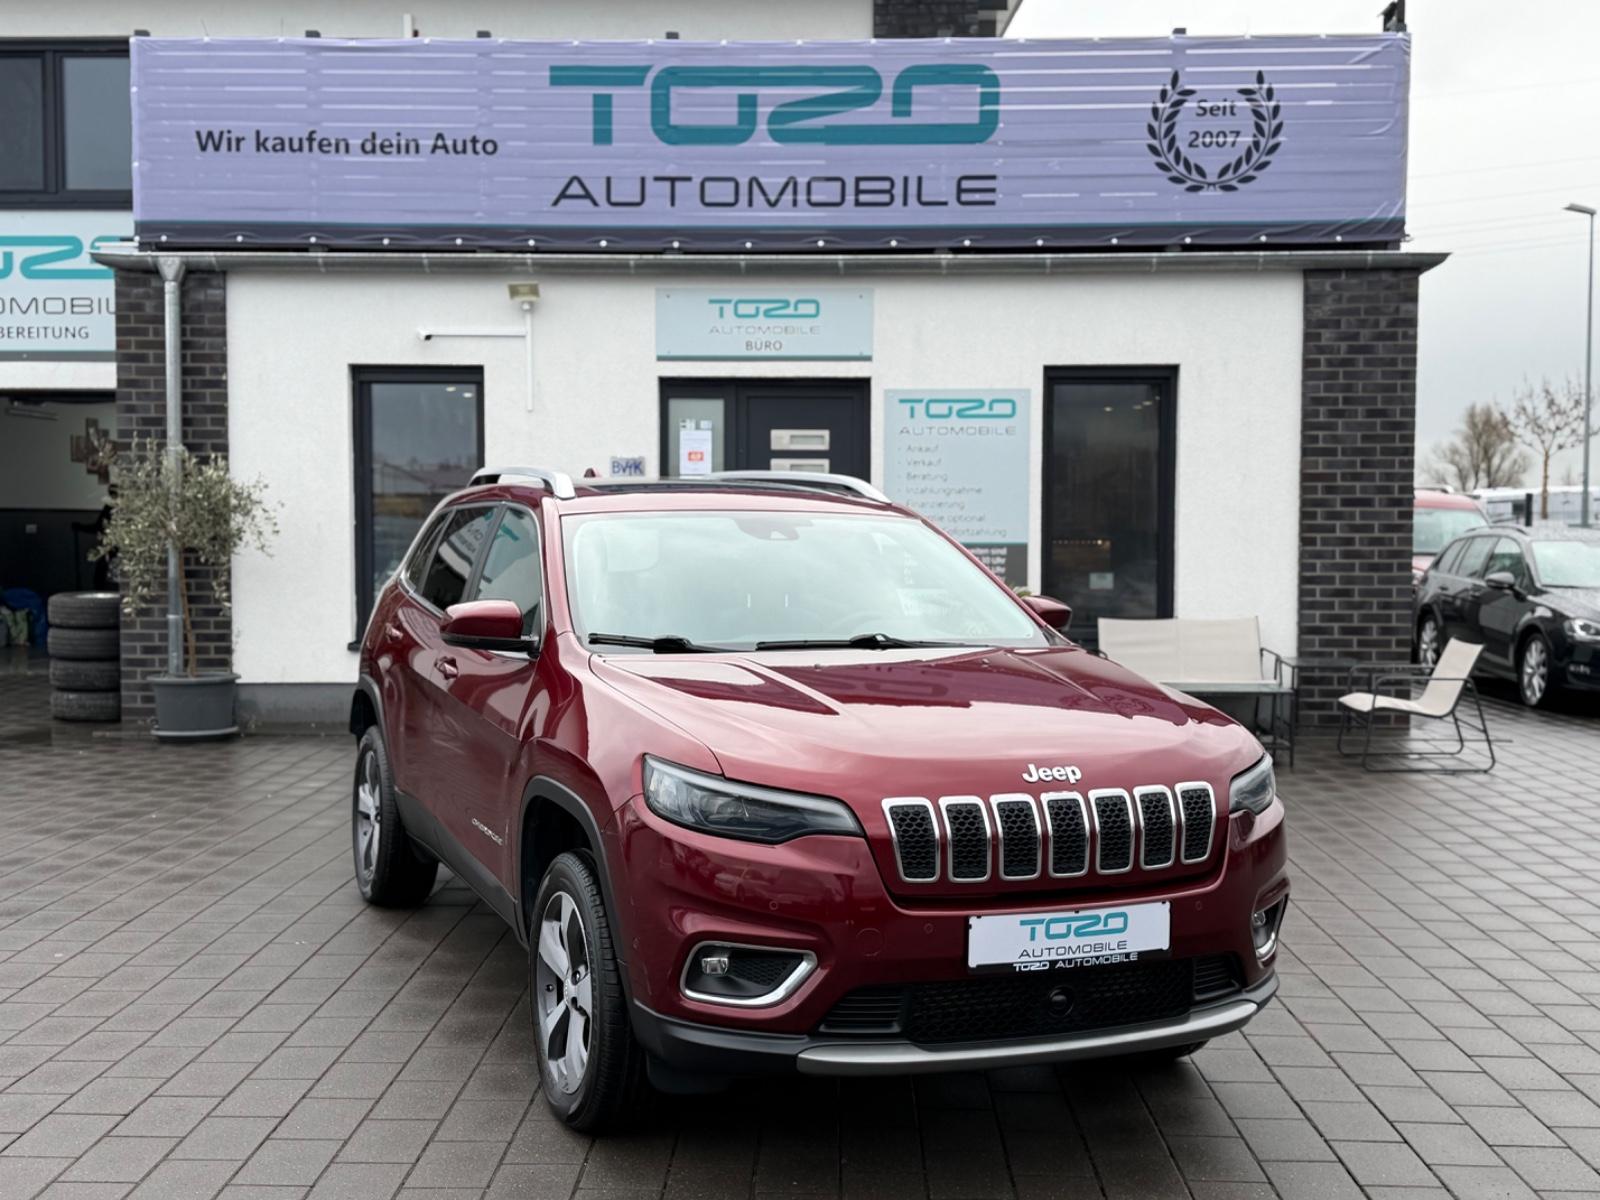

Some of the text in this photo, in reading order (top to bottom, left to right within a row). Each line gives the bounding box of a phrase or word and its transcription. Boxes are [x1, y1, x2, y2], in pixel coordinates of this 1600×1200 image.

[549, 64, 1000, 146] TOZO
[1195, 98, 1238, 117] Seit
[196, 130, 498, 155] Wir kaufen dein Auto
[1188, 130, 1241, 148] 2007
[551, 175, 998, 208] AUTOMOBILE
[708, 325, 821, 335] AUTOMOBILE
[745, 338, 783, 351] BÜRO
[899, 426, 1016, 436] AUTOMOBILE
[906, 472, 948, 483] Beratung
[1022, 764, 1082, 784] Jeep
[1018, 940, 1128, 960] AUTOMOBILE
[1055, 952, 1138, 969] AUTOMOBILE
